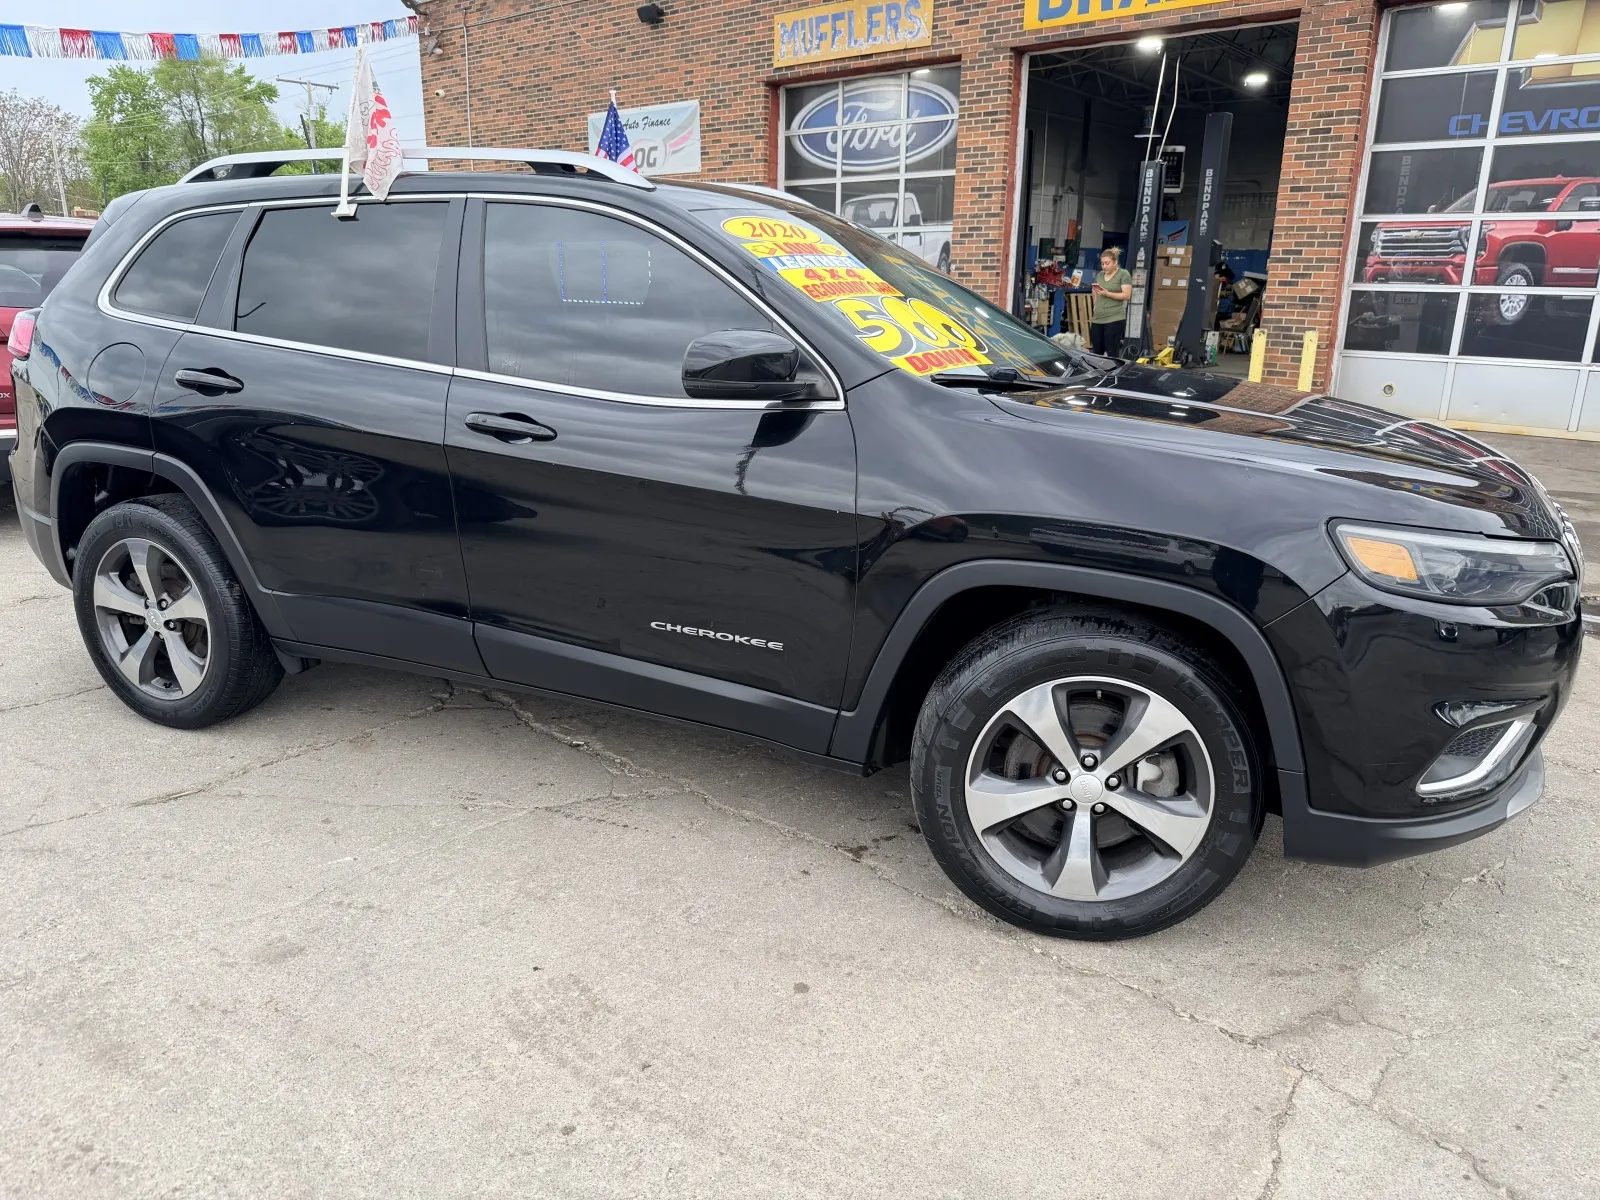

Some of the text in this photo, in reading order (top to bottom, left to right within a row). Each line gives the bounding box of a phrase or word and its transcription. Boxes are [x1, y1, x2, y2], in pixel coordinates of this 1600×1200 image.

[779, 0, 925, 59] MUFFLERS
[622, 115, 671, 131] Auto Finance
[826, 99, 920, 153] Ford
[1140, 168, 1154, 232] BENDPAK
[1200, 168, 1214, 227] BENDPAK
[742, 221, 806, 240] 2020
[768, 254, 860, 269] LEATHER
[773, 242, 824, 255] LOOK
[802, 281, 874, 299] ECONOMY
[833, 297, 987, 358] 500
[906, 347, 978, 375] DOWN
[650, 621, 784, 651] CHEROKEE
